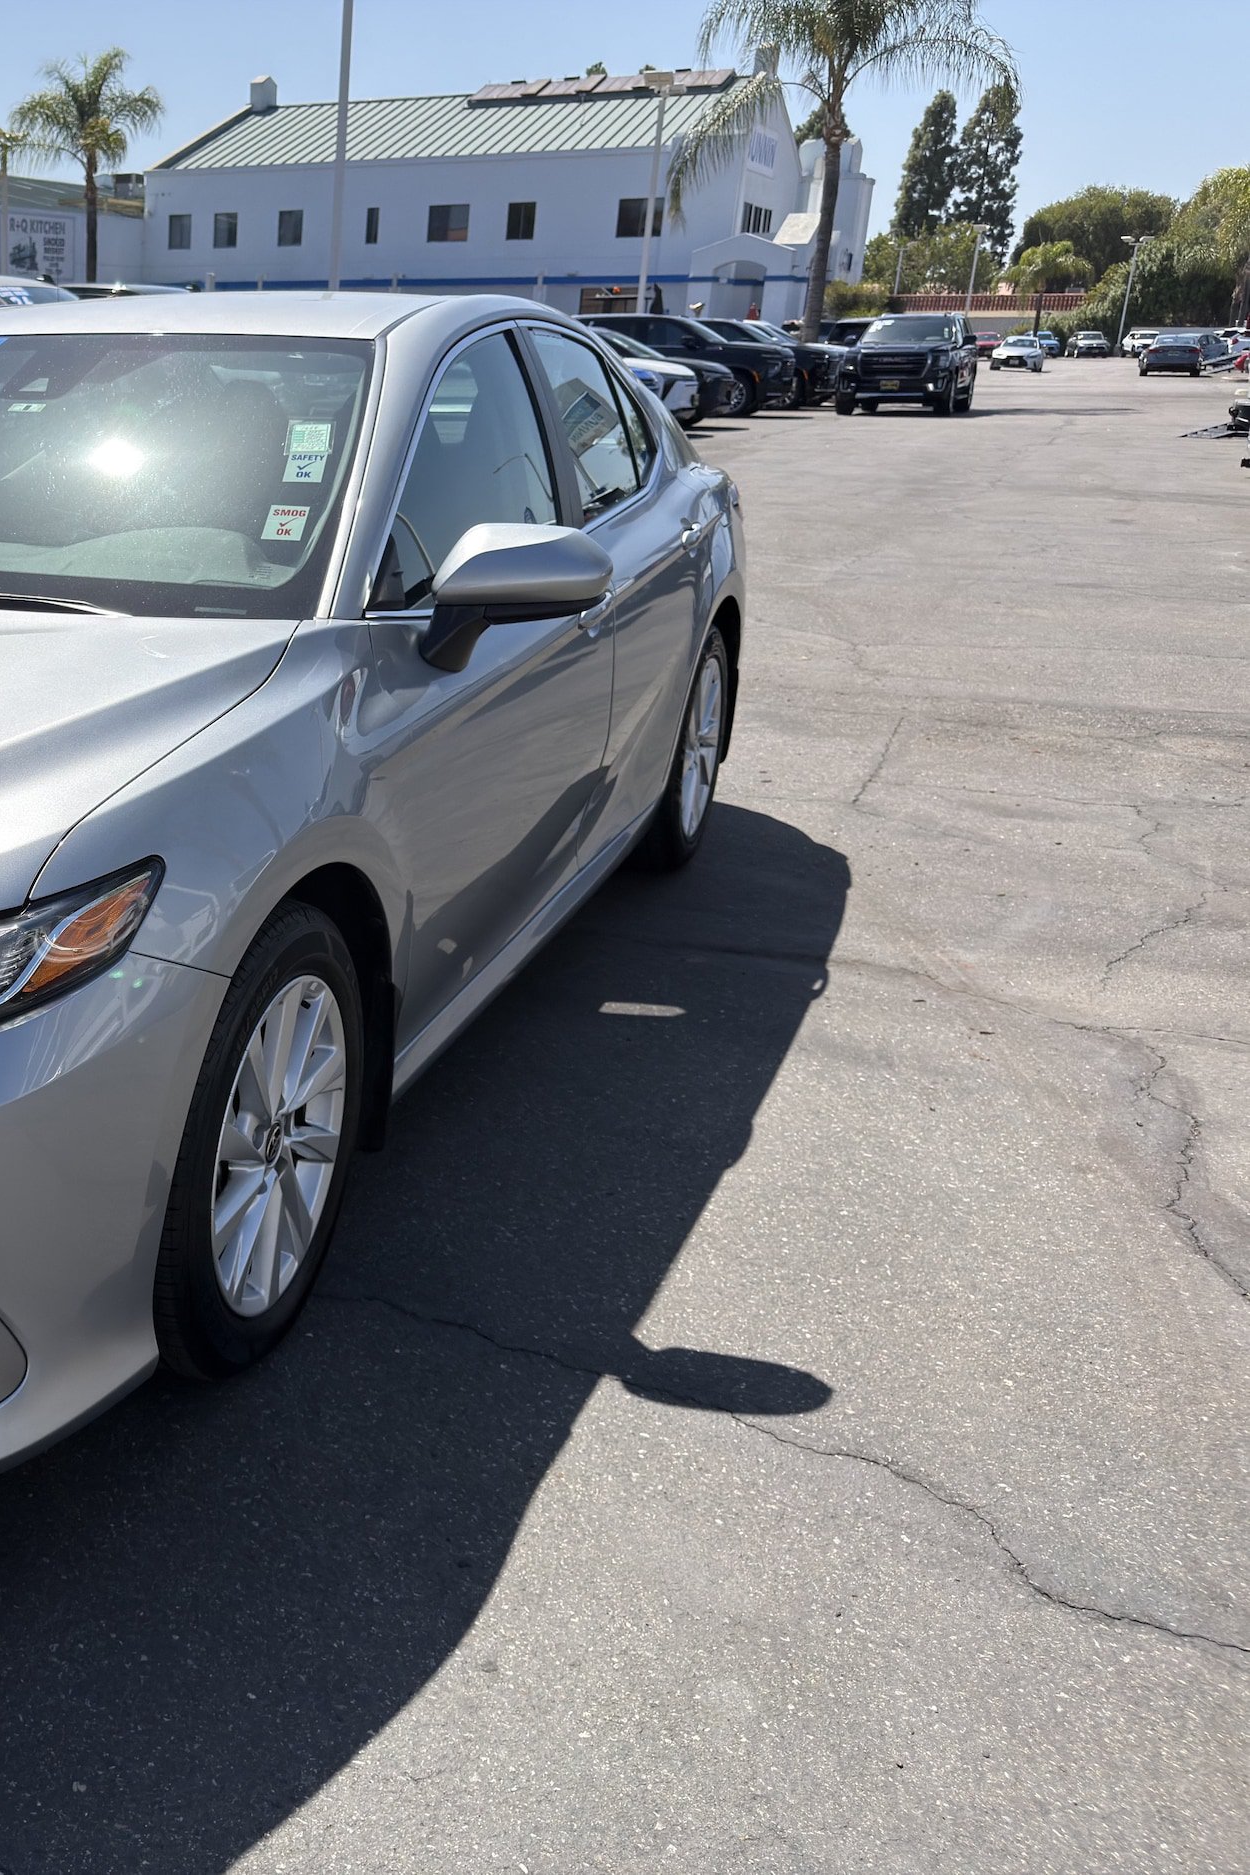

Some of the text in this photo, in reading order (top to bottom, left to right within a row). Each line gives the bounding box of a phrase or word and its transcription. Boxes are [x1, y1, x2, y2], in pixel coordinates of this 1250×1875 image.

[30, 219, 66, 235] KITCHEN
[273, 509, 307, 517] SMOG
[276, 528, 292, 536] OK
